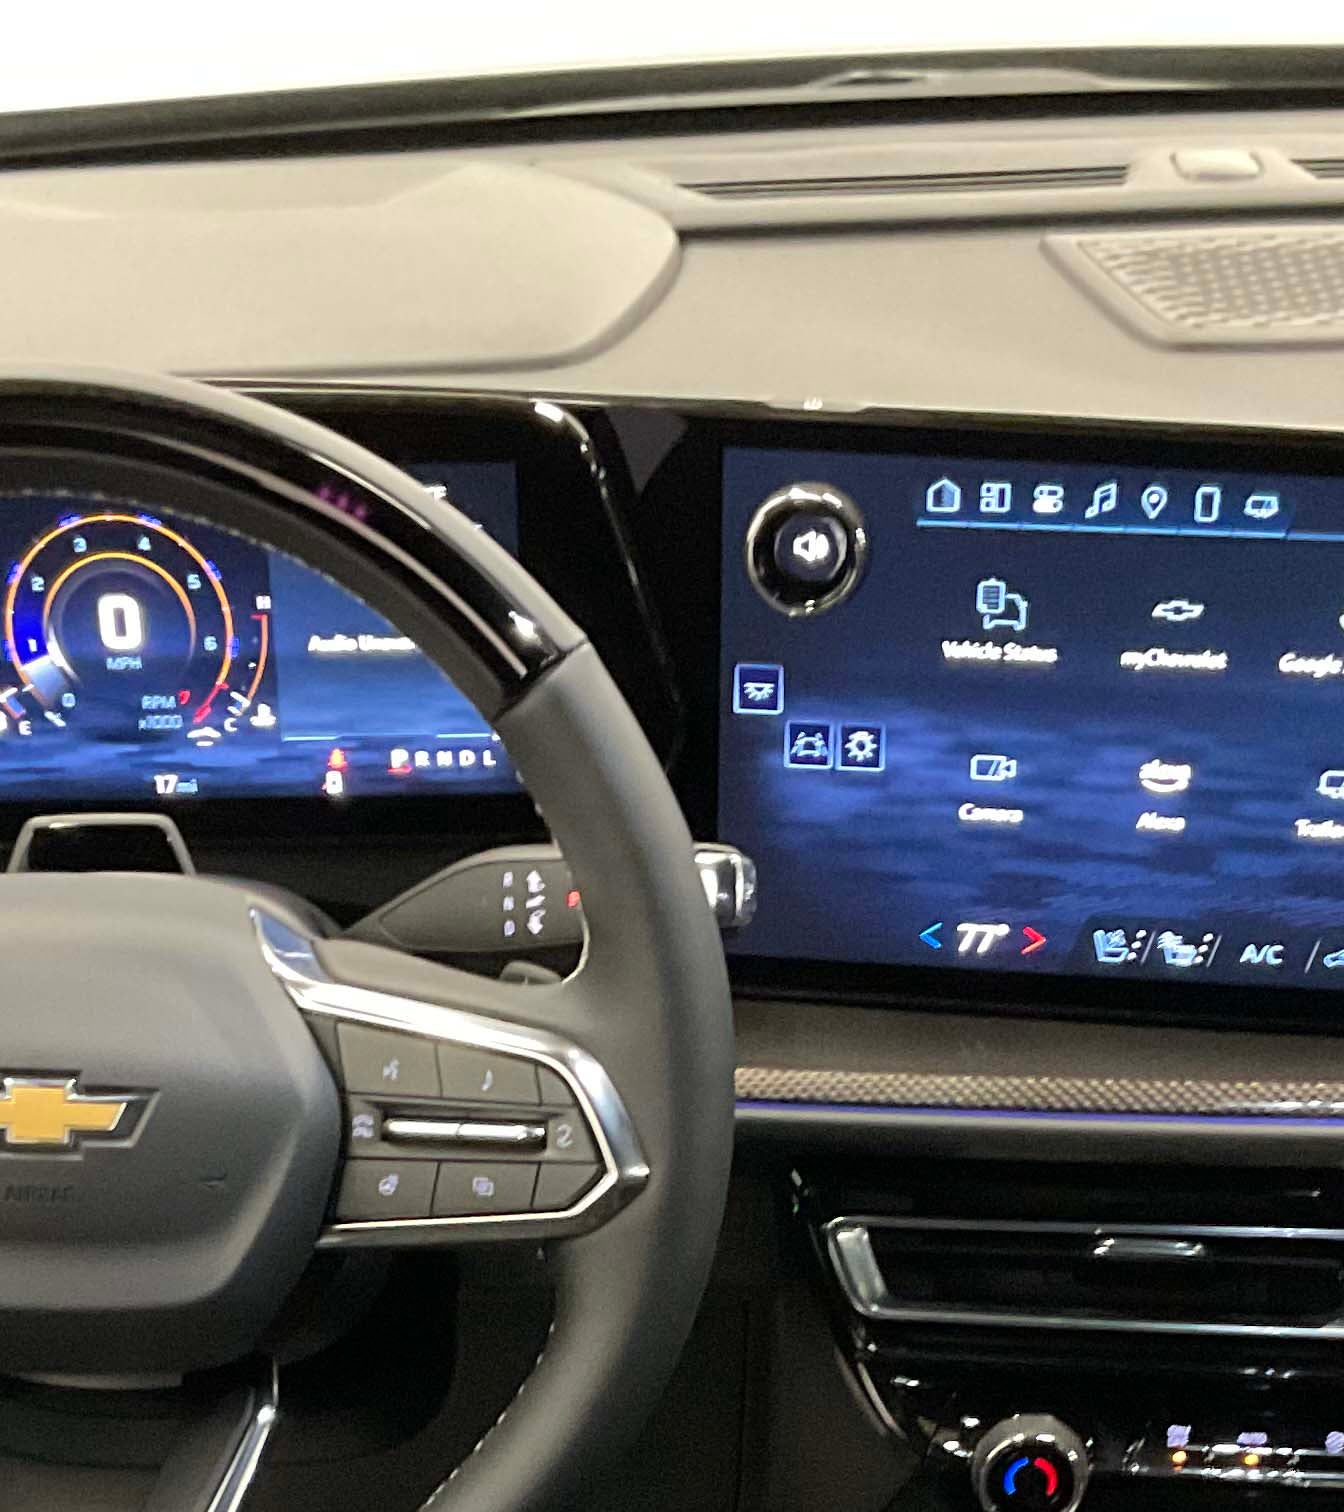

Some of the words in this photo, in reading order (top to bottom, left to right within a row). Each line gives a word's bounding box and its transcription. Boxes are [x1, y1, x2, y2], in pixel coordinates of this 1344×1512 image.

[73, 537, 87, 552] 3
[138, 537, 151, 551] 4
[32, 577, 45, 591] 2
[187, 574, 201, 589] 5
[98, 593, 142, 650] 0
[203, 636, 217, 650] 6
[106, 656, 142, 670] MPH
[142, 695, 177, 709] RPM
[390, 749, 409, 768] P
[1239, 943, 1284, 965] A/C
